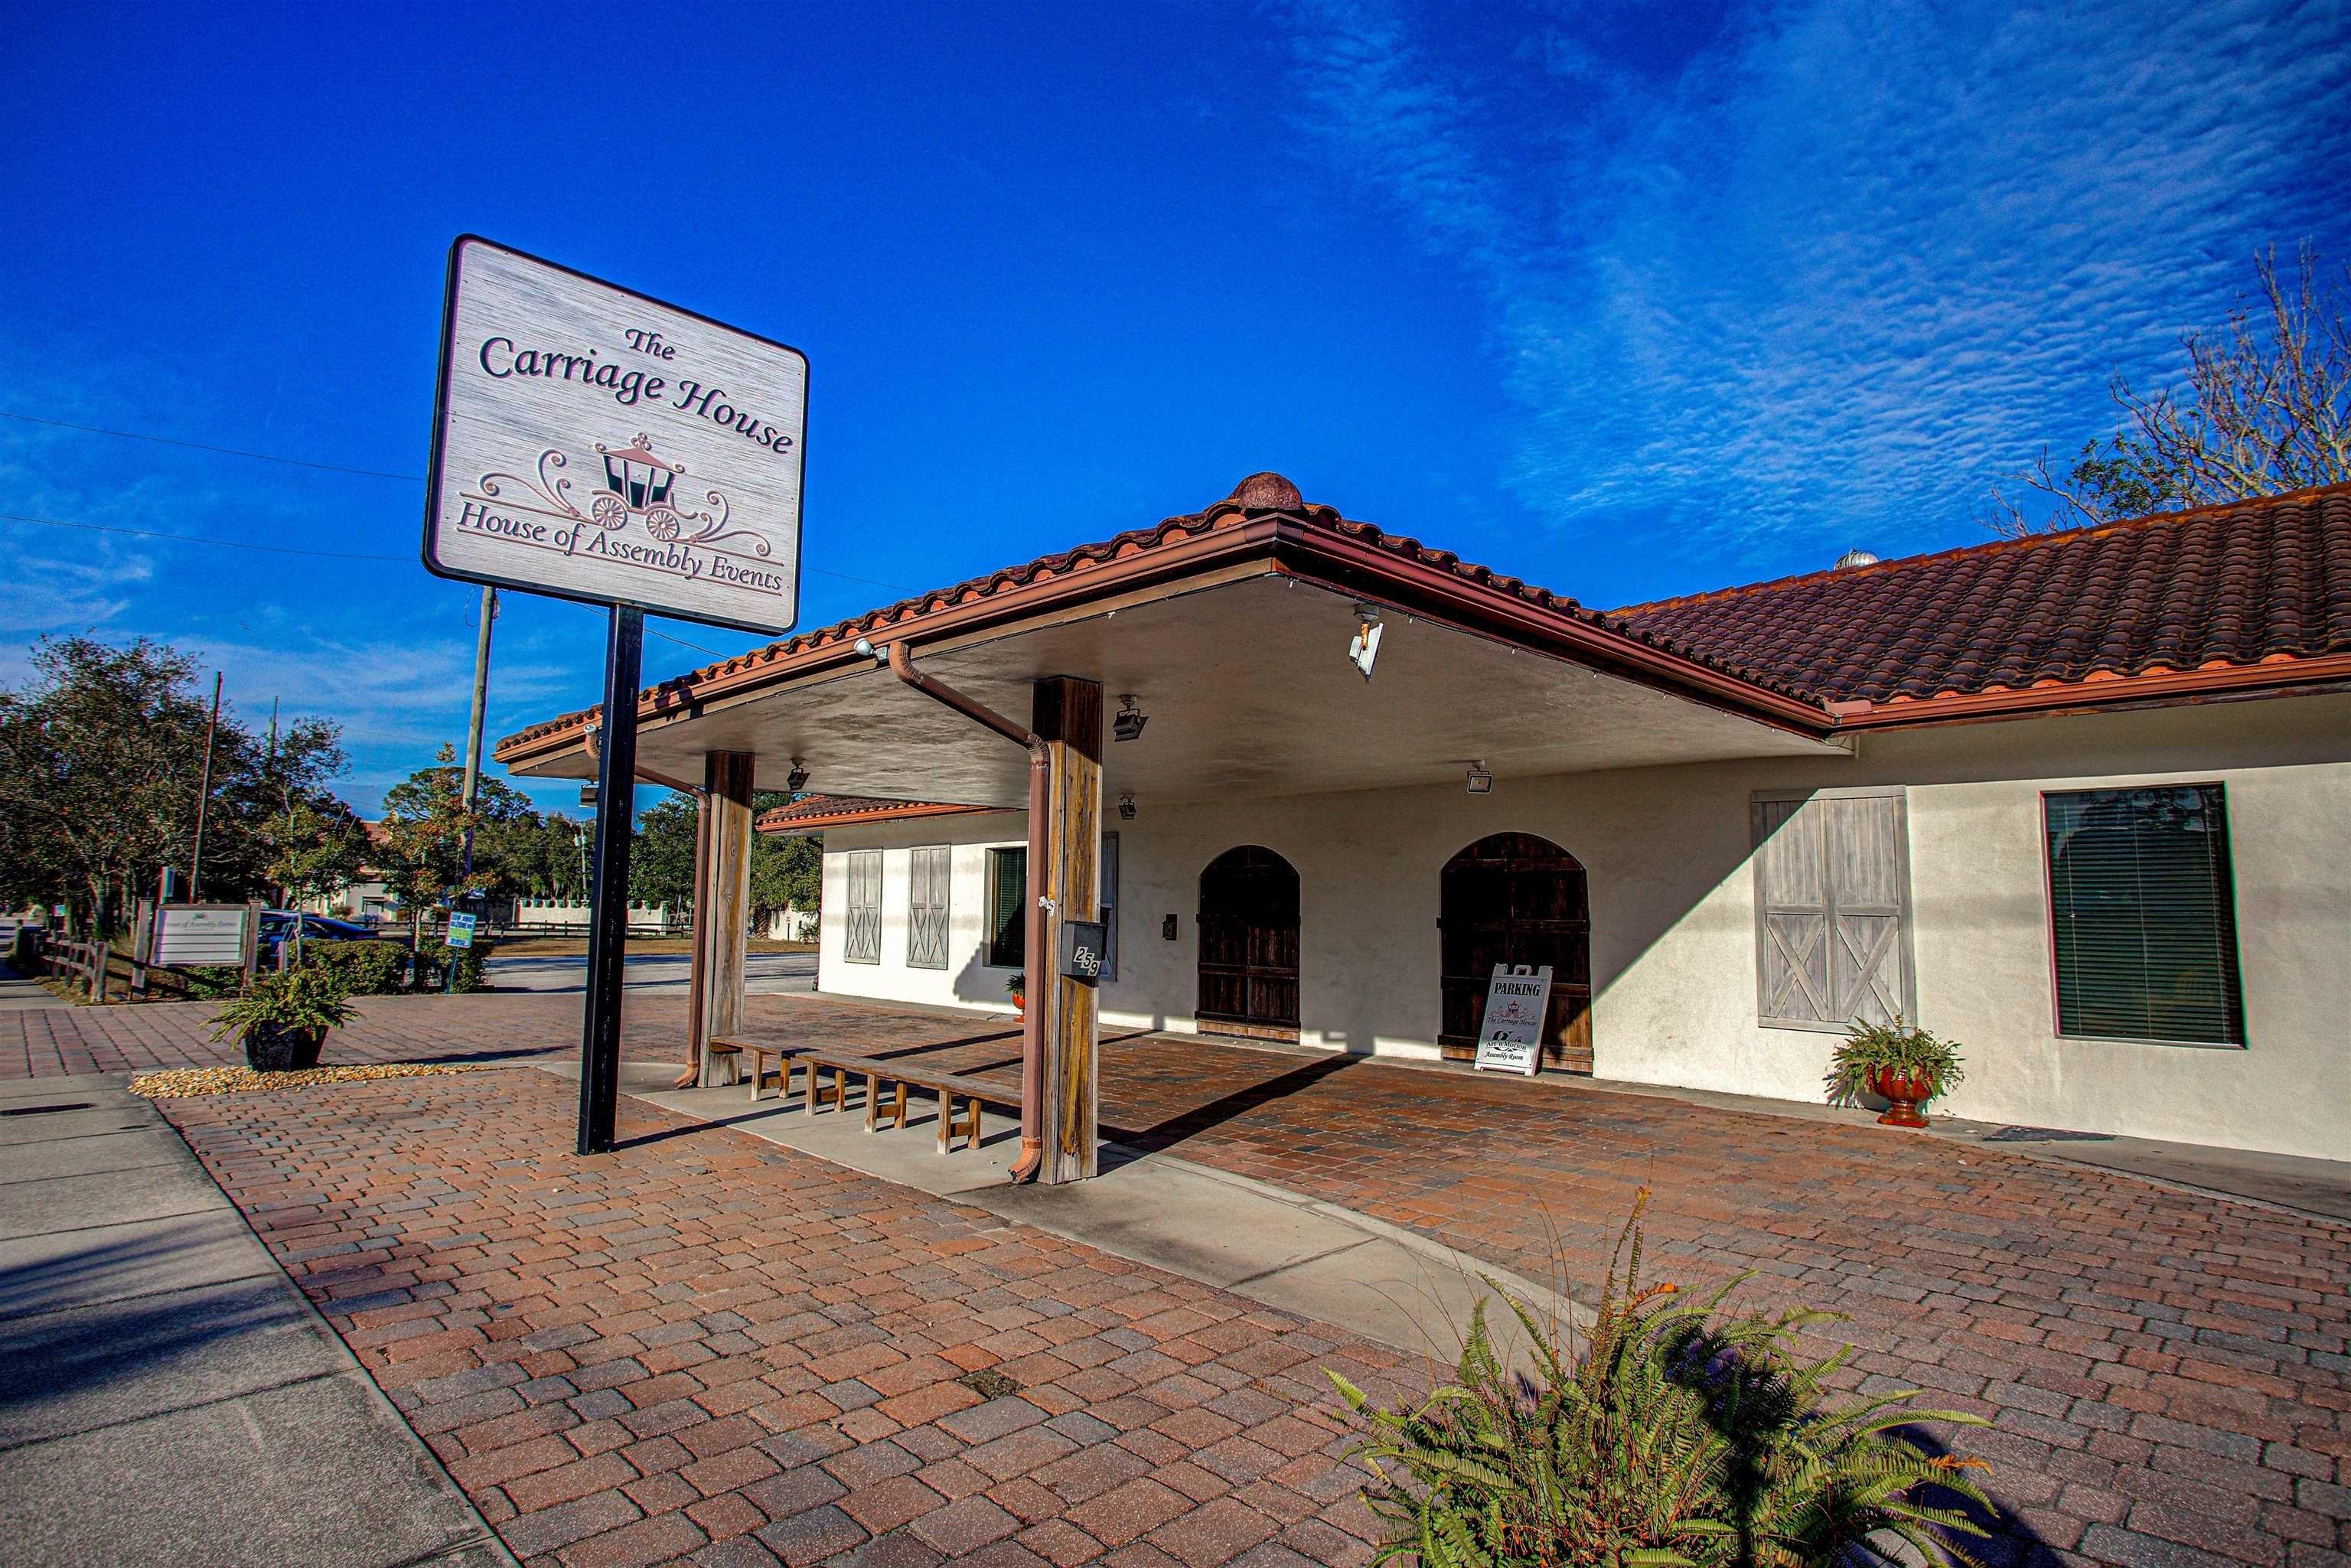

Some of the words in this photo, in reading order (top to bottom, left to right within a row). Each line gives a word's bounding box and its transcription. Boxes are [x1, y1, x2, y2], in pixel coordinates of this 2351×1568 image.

[624, 328, 676, 360] The
[478, 336, 665, 406] Carriage
[672, 380, 794, 454] House
[457, 501, 547, 542] House
[553, 522, 587, 556] of
[585, 530, 703, 580] Assembly
[709, 554, 783, 591] Events
[1075, 947, 1098, 975] 259
[1493, 982, 1541, 996] PARKING
[1497, 1017, 1518, 1026] Carriage
[1484, 1051, 1508, 1061] Assembly
[1503, 1041, 1527, 1051] Motion
